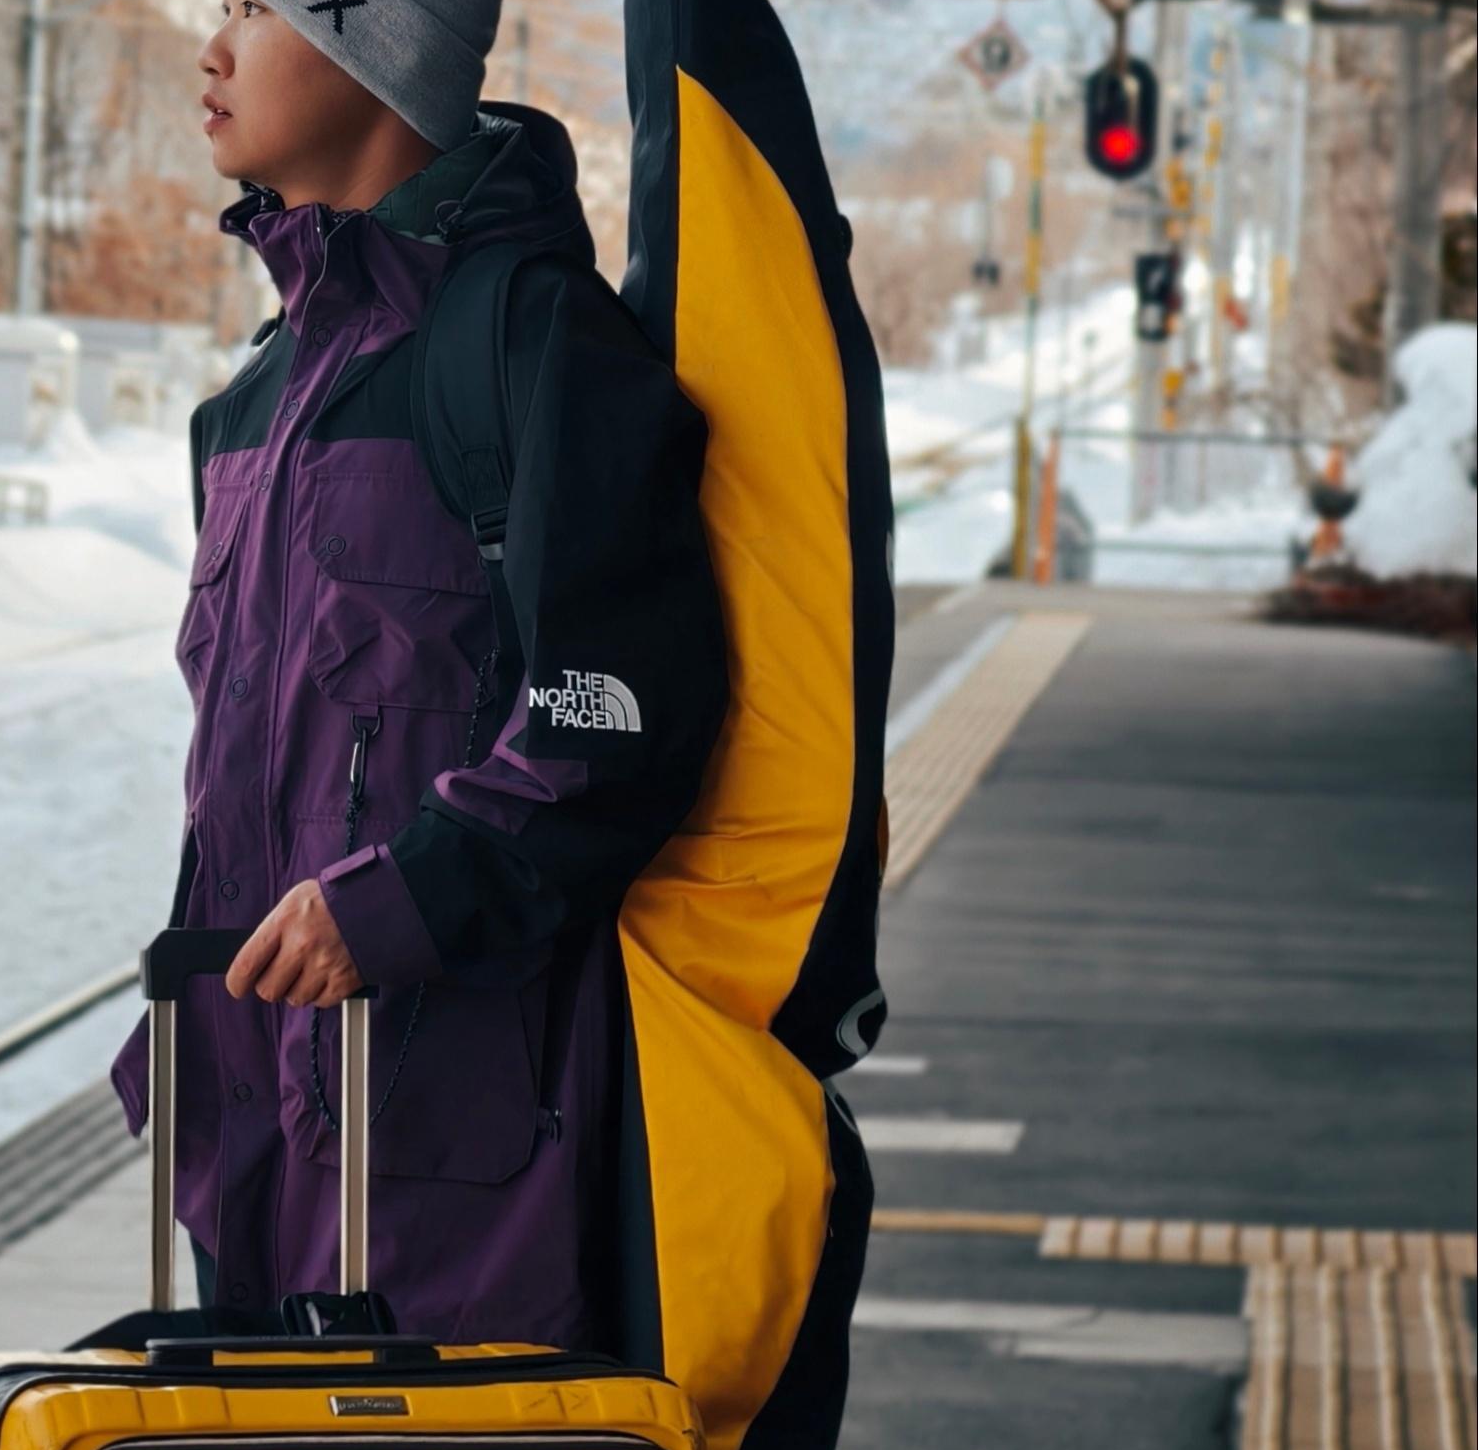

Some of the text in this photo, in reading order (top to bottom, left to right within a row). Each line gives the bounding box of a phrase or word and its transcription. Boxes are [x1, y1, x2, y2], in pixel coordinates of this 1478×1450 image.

[562, 669, 603, 691] THE
[529, 687, 604, 710] NORTH
[551, 707, 606, 729] FACE
